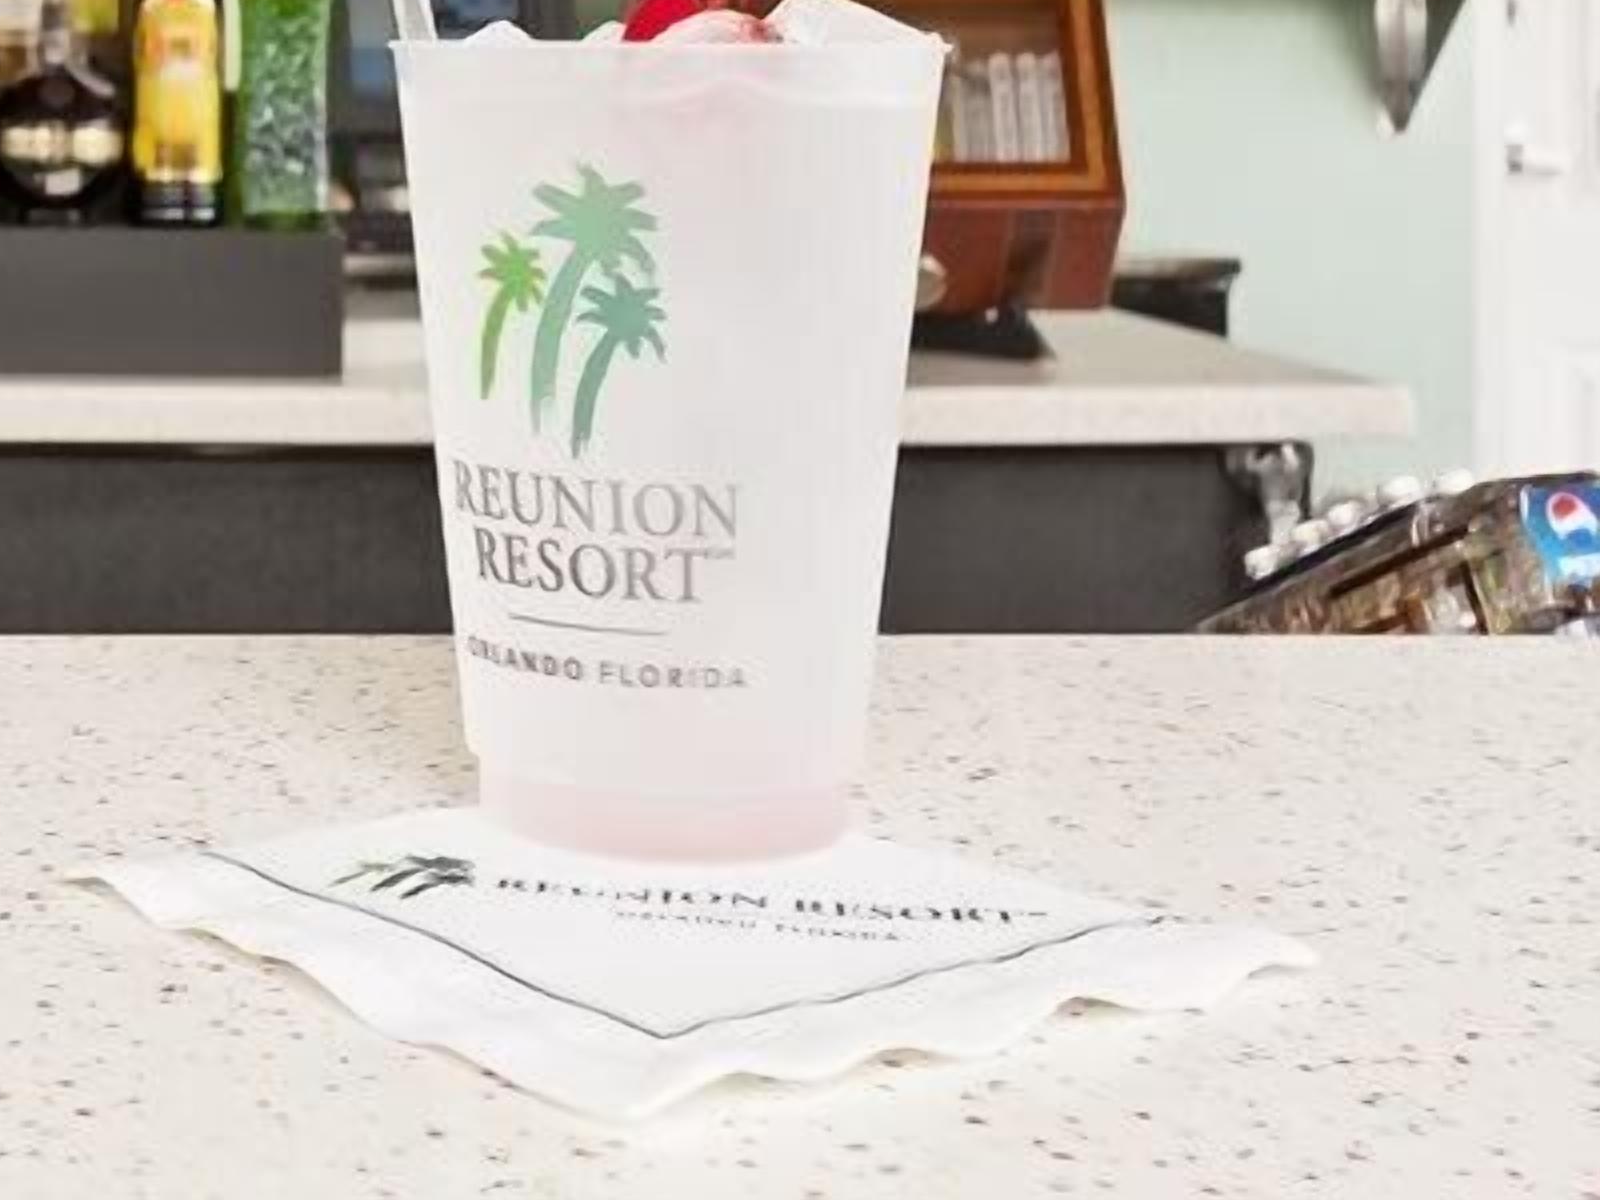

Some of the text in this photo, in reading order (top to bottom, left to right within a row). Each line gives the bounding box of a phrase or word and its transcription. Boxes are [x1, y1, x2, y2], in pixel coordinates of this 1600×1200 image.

[452, 459, 738, 539] REUNION
[474, 527, 704, 602] RESORT
[467, 635, 749, 689] ORLANDO FLORIDA
